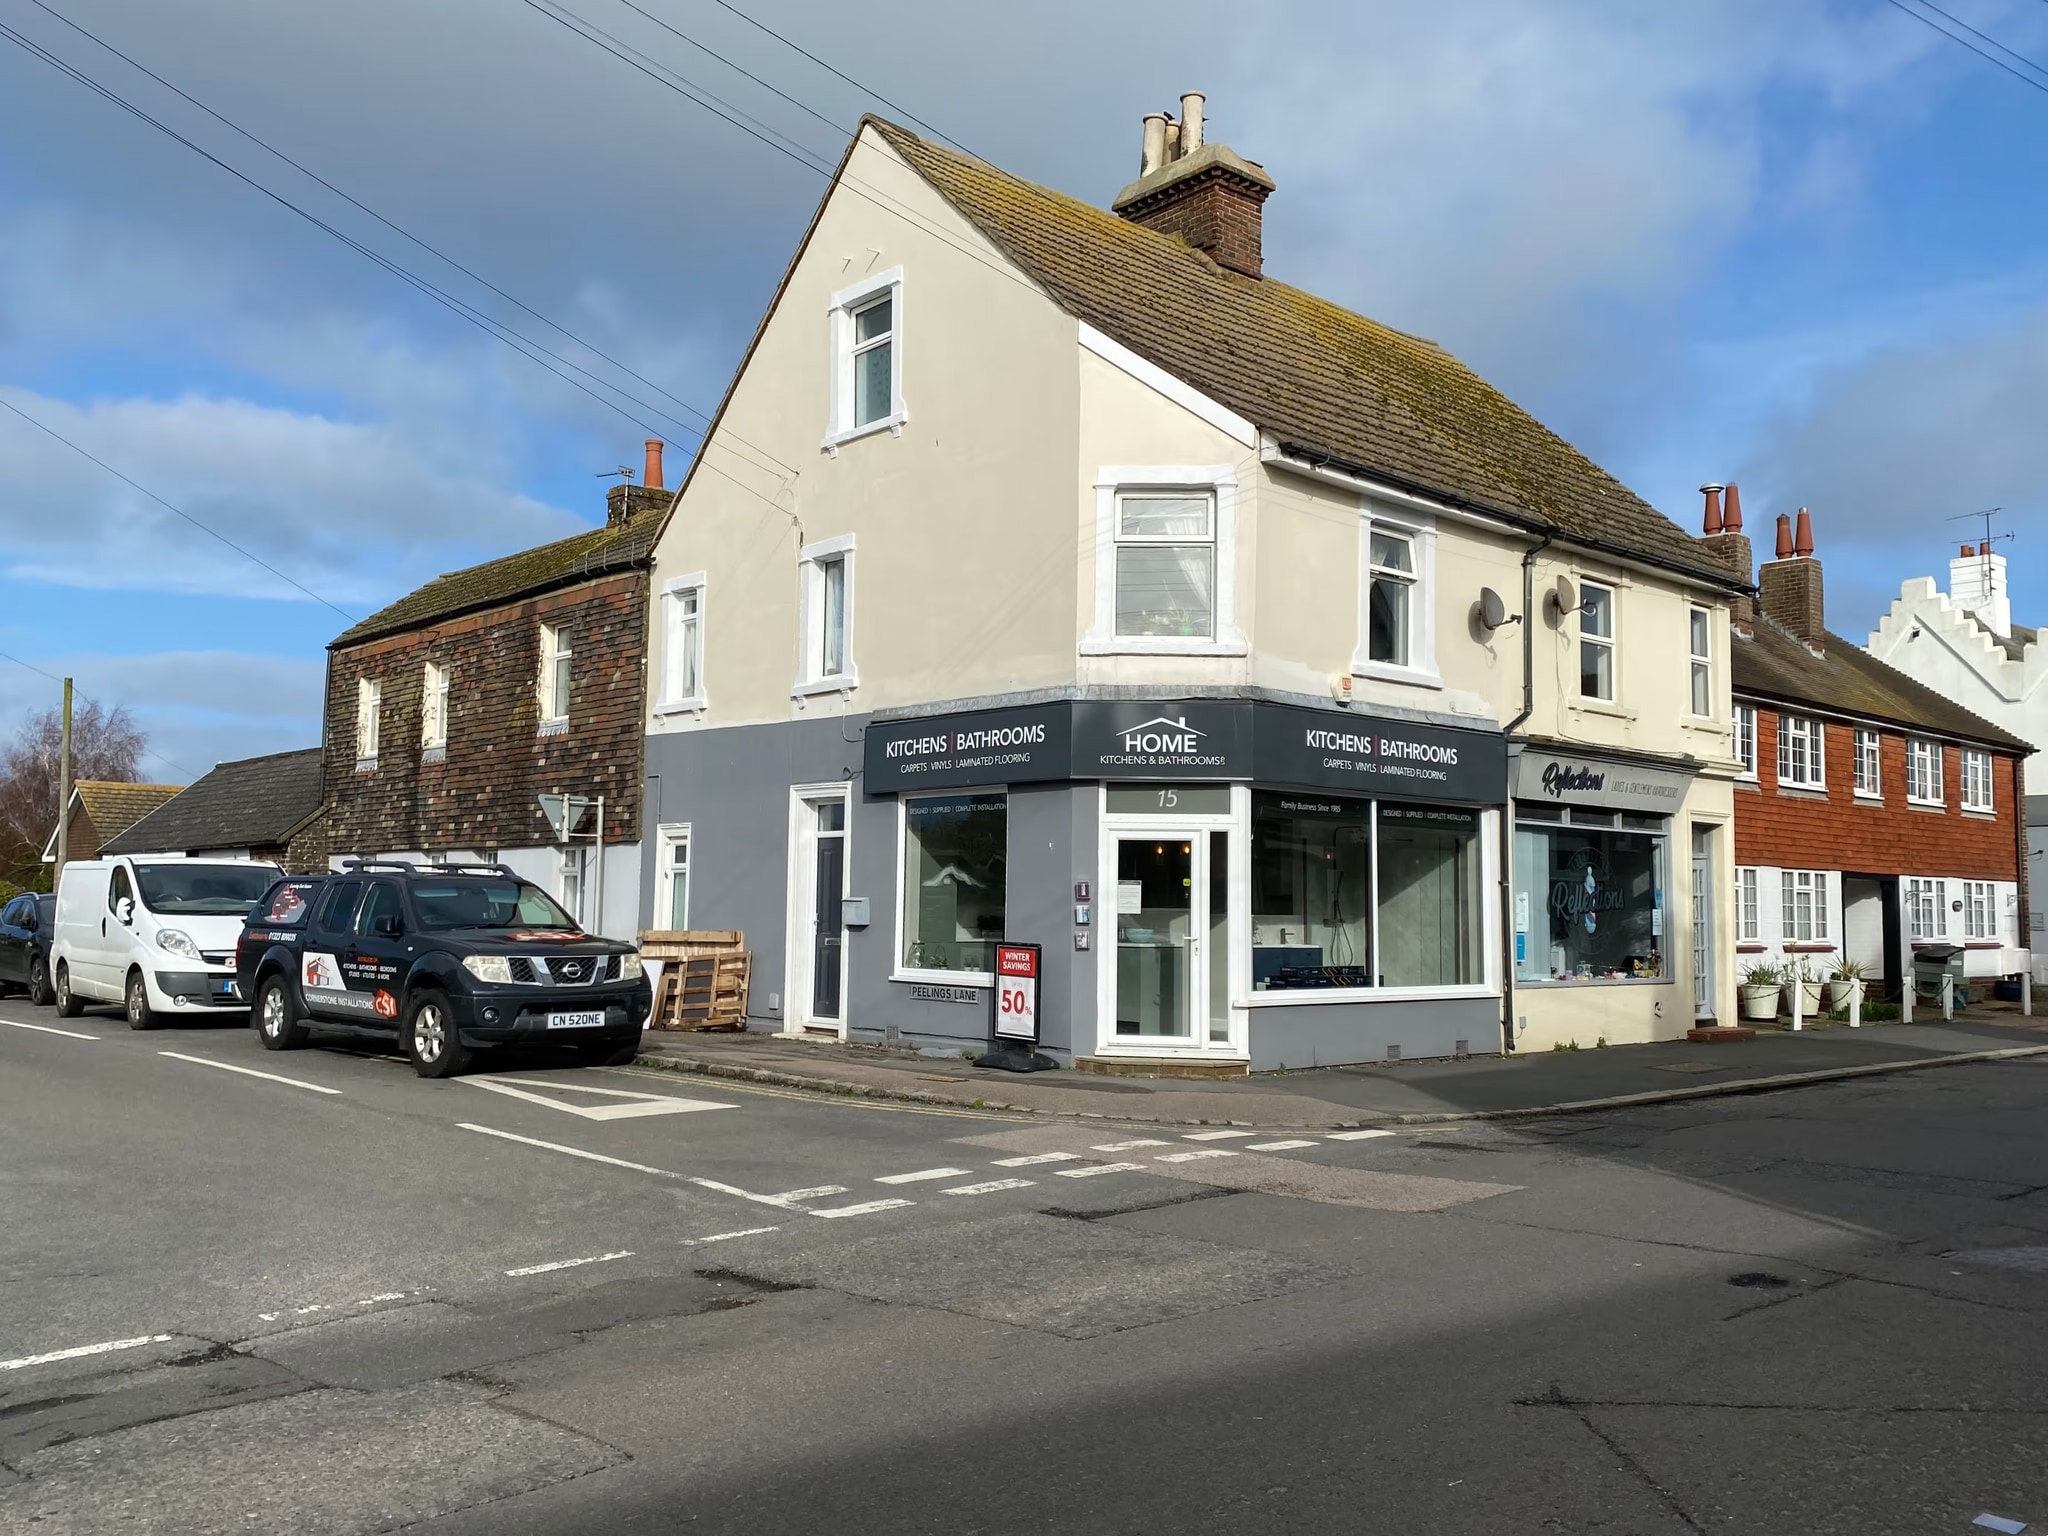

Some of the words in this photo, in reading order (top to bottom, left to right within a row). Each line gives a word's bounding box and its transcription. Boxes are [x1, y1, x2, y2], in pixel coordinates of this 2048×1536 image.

[886, 735, 947, 758] KITCHENS
[956, 724, 1045, 751] BATHROOMS
[1125, 734, 1197, 753] HOME
[1306, 729, 1372, 754] KITCHENS
[1380, 739, 1458, 765] BATHROOMS
[900, 762, 927, 773] CARPETS
[930, 759, 952, 771] VINYLS
[955, 755, 993, 769] LAMINATED
[994, 752, 1030, 765] FLOORING
[1100, 755, 1147, 765] KITCHENS
[1148, 755, 1157, 765] &
[1158, 755, 1220, 766] BATHROOMS
[1323, 757, 1352, 770] CARPETS
[1355, 761, 1377, 773] VINYLS
[1380, 764, 1415, 777] LAMINATED
[1416, 768, 1447, 781] FLOORING
[1542, 761, 1605, 799] Reflections
[932, 806, 951, 814] SUPPLIED
[955, 804, 977, 813] COMPLETE
[977, 802, 1007, 811] INSTALLATION
[1158, 789, 1178, 808] 15
[1317, 803, 1329, 812] Since
[1552, 881, 1625, 925] Reflections
[1002, 961, 1031, 971] SAVINGS
[1004, 951, 1030, 962] WINTER
[305, 993, 338, 1005] CORNERSTONE
[338, 996, 373, 1010] INSTALLATIONS
[912, 986, 951, 999] PEELINGS
[954, 989, 977, 1001] LANE
[1001, 989, 1032, 1016] 50%
[375, 995, 394, 1015] CSI
[552, 1015, 566, 1026] CN
